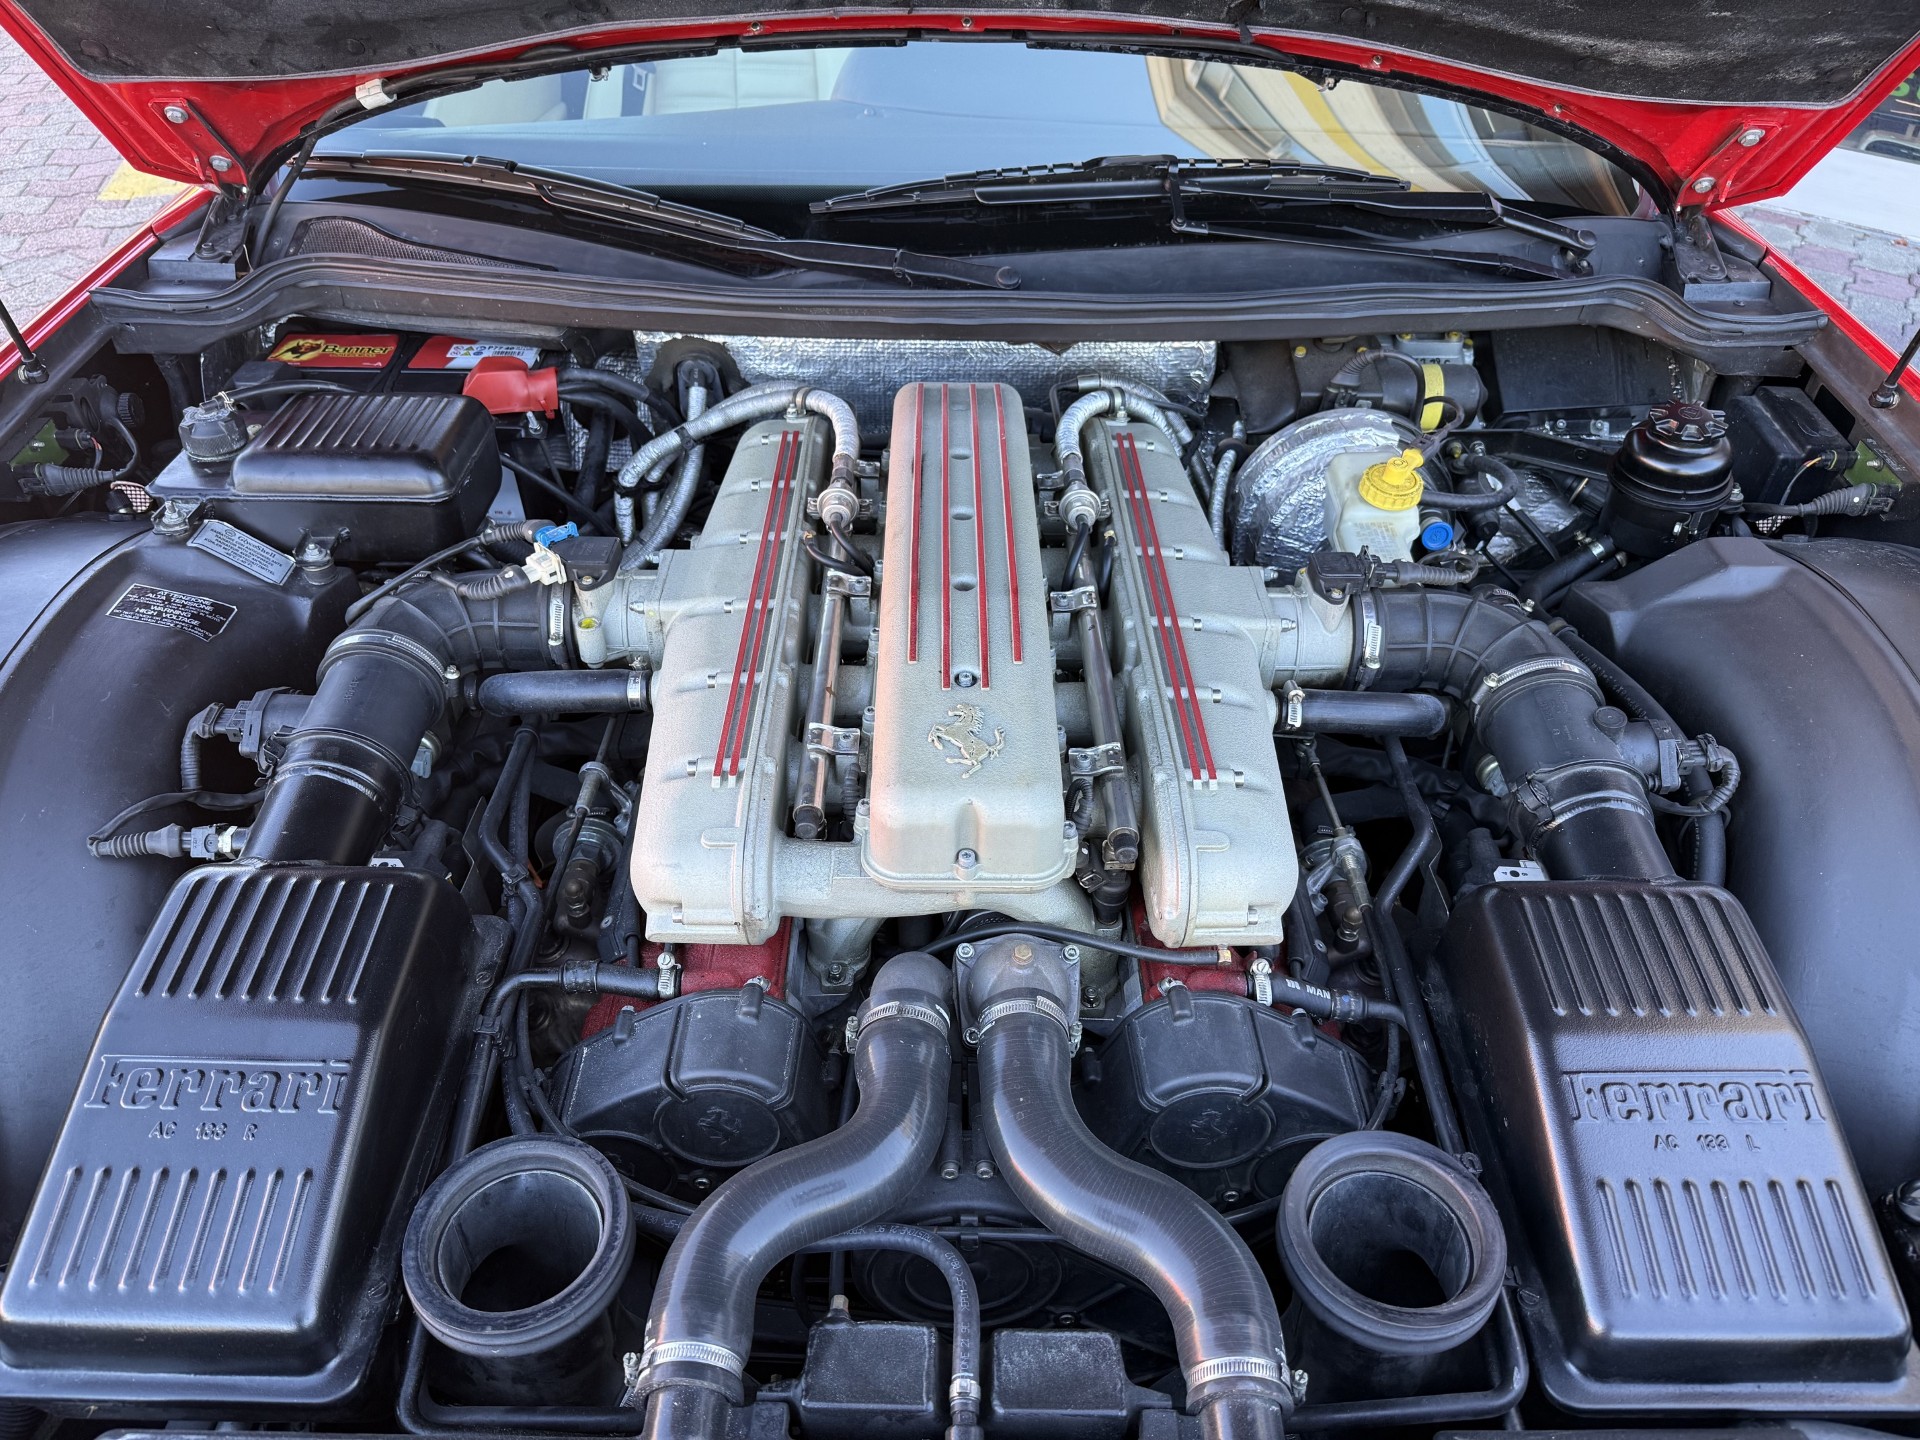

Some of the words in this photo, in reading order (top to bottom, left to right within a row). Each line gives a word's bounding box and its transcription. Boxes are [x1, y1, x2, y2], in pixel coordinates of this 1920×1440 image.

[322, 344, 394, 354] Banner
[237, 536, 276, 559] GlycoShell
[157, 591, 213, 606] ATTENZIONE
[169, 598, 215, 612] TENSIONE
[134, 608, 158, 616] HIGH
[161, 613, 201, 626] VOLTAGE
[149, 605, 193, 617] WARNING
[84, 1054, 350, 1114] Ferrari
[1562, 1069, 1826, 1124] Ferrari
[148, 1121, 177, 1139] AC
[1745, 1134, 1761, 1152] L
